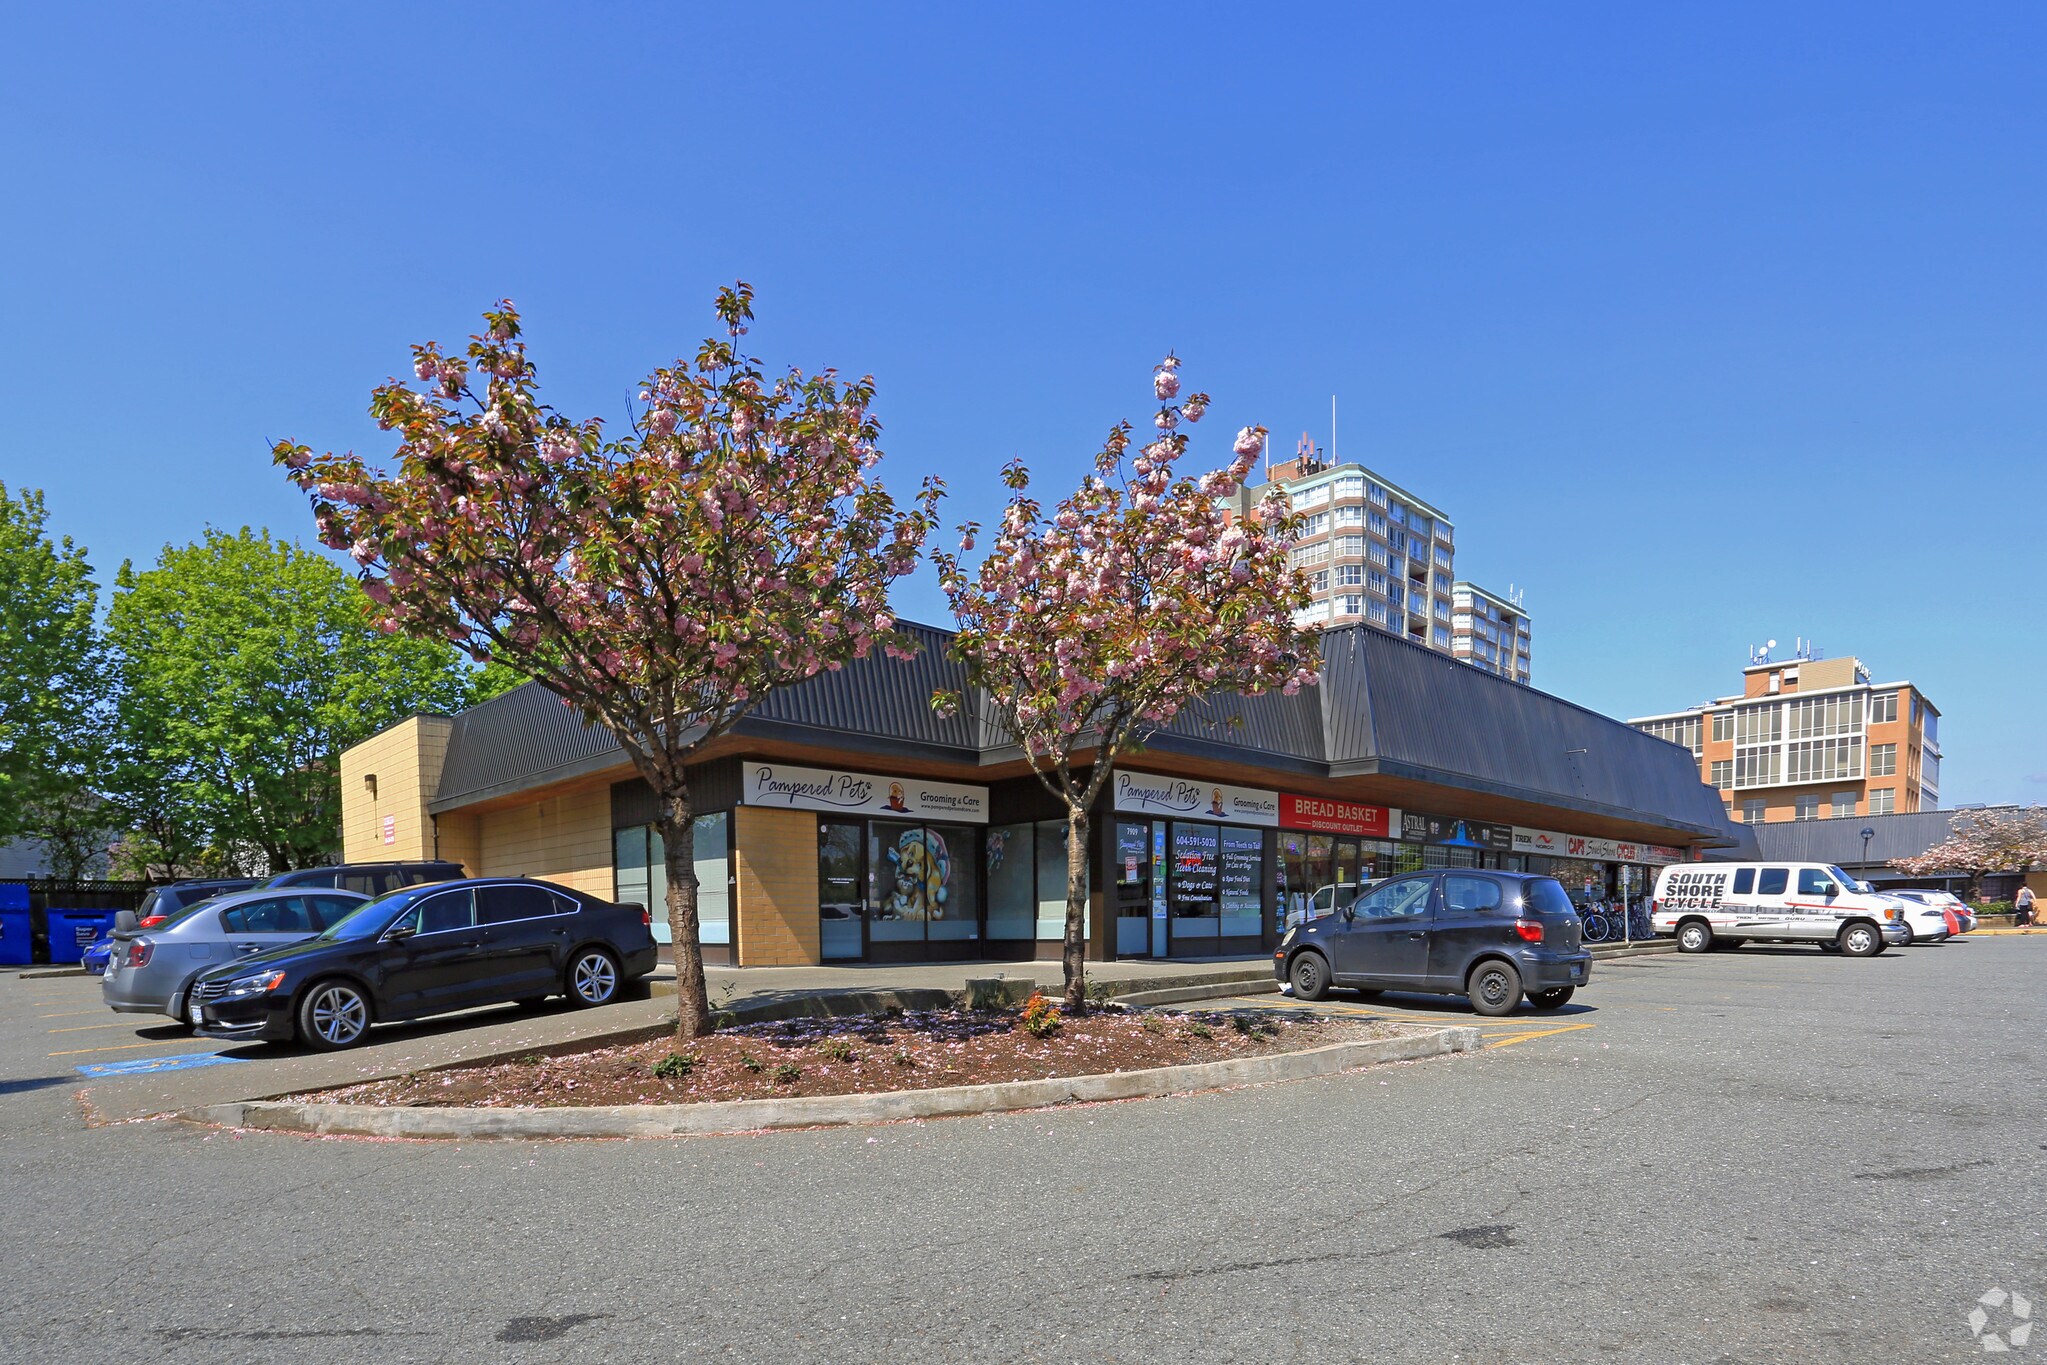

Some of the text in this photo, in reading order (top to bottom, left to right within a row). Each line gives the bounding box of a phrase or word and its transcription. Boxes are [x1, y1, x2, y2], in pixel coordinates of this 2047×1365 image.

[756, 767, 868, 804] Pampered Pets
[1119, 774, 1198, 808] Pampered Pets
[920, 792, 956, 806] Grooming
[963, 796, 980, 806] Care
[1233, 797, 1259, 810] Grooming
[1263, 800, 1275, 810] Care
[1296, 799, 1377, 822] BREAD BASKET
[1312, 820, 1363, 832] DISCOUNT OUTLET
[1402, 814, 1426, 831] ASTRAL
[1176, 836, 1216, 847] 604-591-5020
[1515, 834, 1532, 843] TREK
[1568, 837, 1585, 855] CAPS
[1617, 843, 1635, 860] CYCLES
[1176, 849, 1214, 861] Sedation Free
[1175, 862, 1216, 876] Teeth Cleaning
[1668, 874, 1727, 884] SOUTH
[1182, 880, 1195, 891] Dogs
[1202, 881, 1213, 890] Cats
[1666, 885, 1724, 896] SHORE
[1664, 898, 1722, 908] CYCLE
